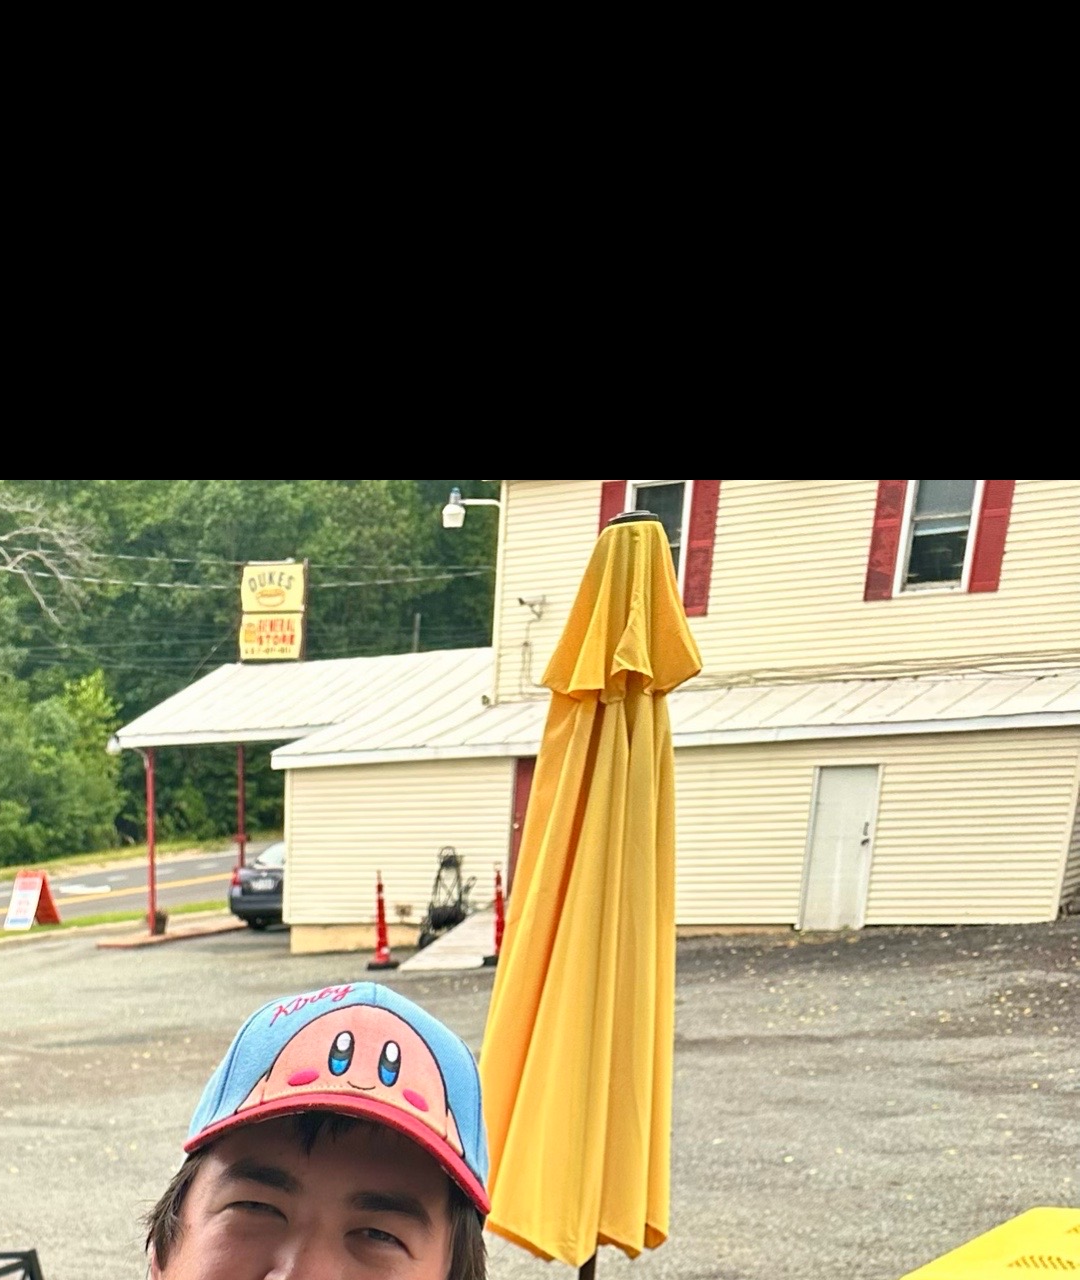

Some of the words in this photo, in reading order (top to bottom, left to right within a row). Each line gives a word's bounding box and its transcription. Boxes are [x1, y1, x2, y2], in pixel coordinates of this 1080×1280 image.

[248, 571, 295, 592] DUKES
[258, 619, 295, 632] GENERAL
[257, 634, 295, 646] STORE
[269, 983, 356, 1027] Kirby
